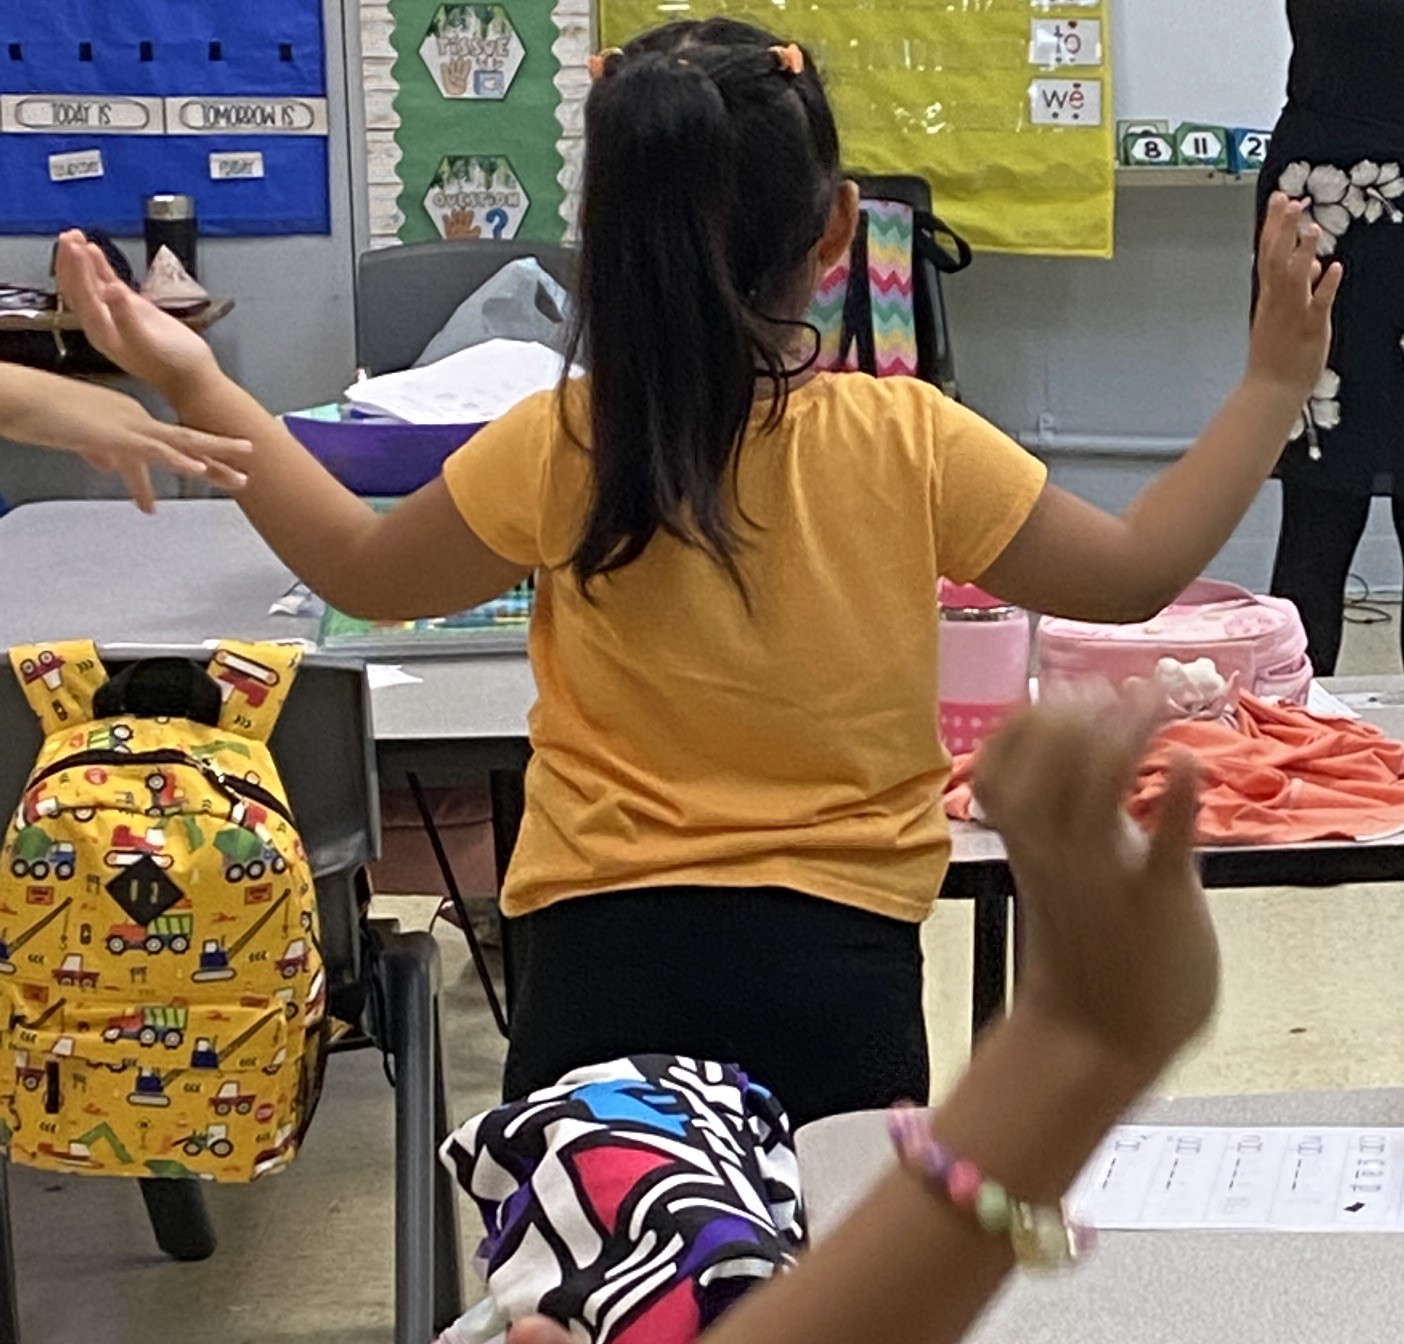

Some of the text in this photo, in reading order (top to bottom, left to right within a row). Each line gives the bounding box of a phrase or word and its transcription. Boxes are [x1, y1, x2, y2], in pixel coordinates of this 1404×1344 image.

[437, 37, 510, 57] TISSUE
[1053, 25, 1081, 54] to
[1043, 87, 1084, 109] we
[52, 105, 111, 124] TODAY IS
[203, 105, 295, 125] TOMORROW IS
[1144, 141, 1161, 158] 8
[432, 191, 520, 207] QUESTION
